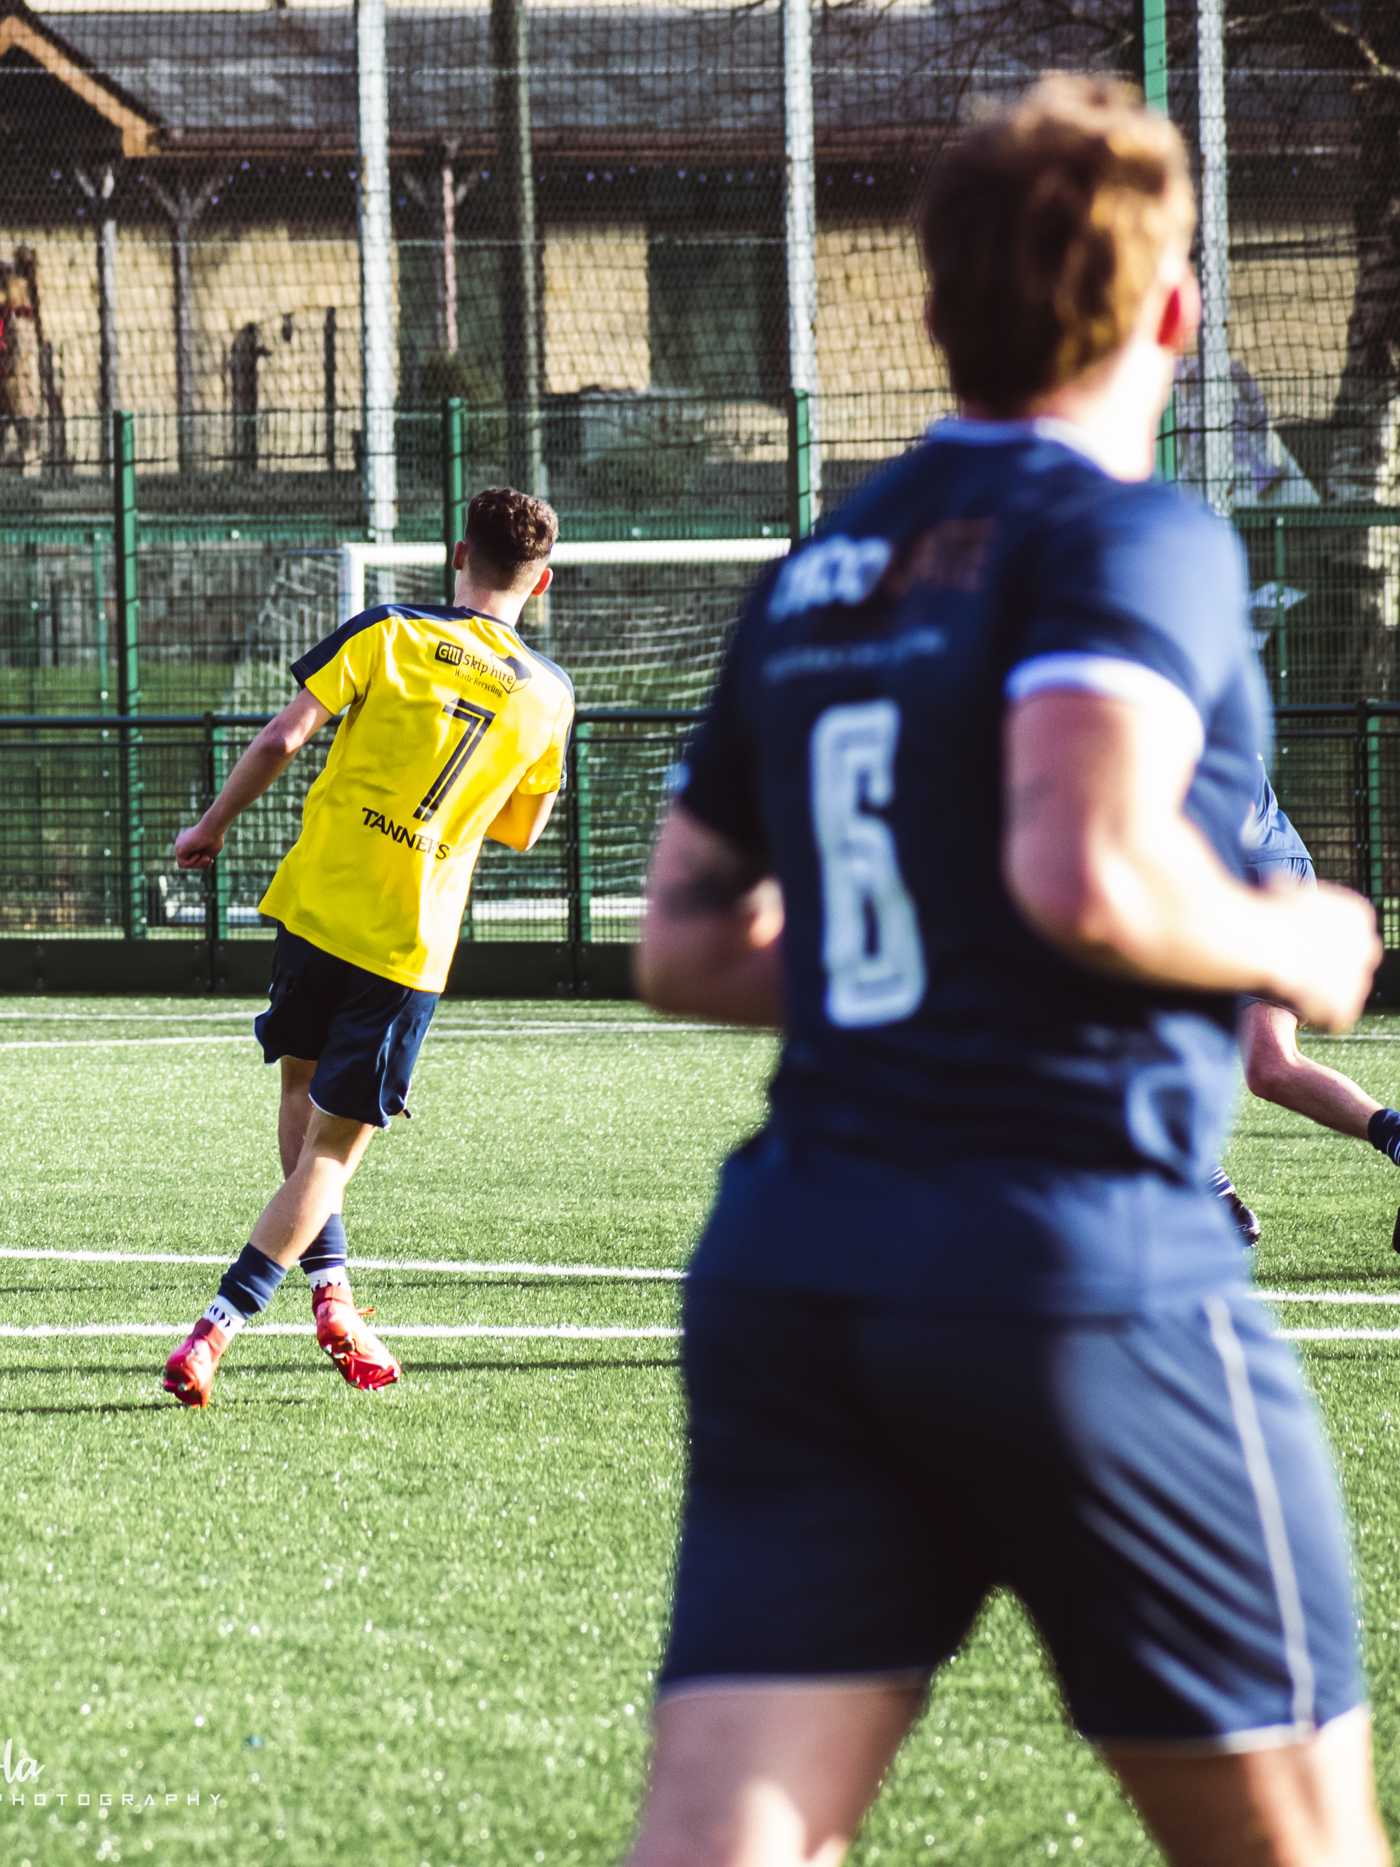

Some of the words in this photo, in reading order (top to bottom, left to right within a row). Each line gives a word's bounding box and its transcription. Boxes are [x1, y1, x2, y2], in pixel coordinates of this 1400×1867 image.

[438, 644, 461, 664] Gill
[462, 654, 489, 677] Skip
[490, 664, 514, 685] hire
[454, 668, 474, 683] Waste
[473, 679, 504, 698] Recycling
[413, 697, 497, 823] 7
[809, 699, 928, 1028] 6
